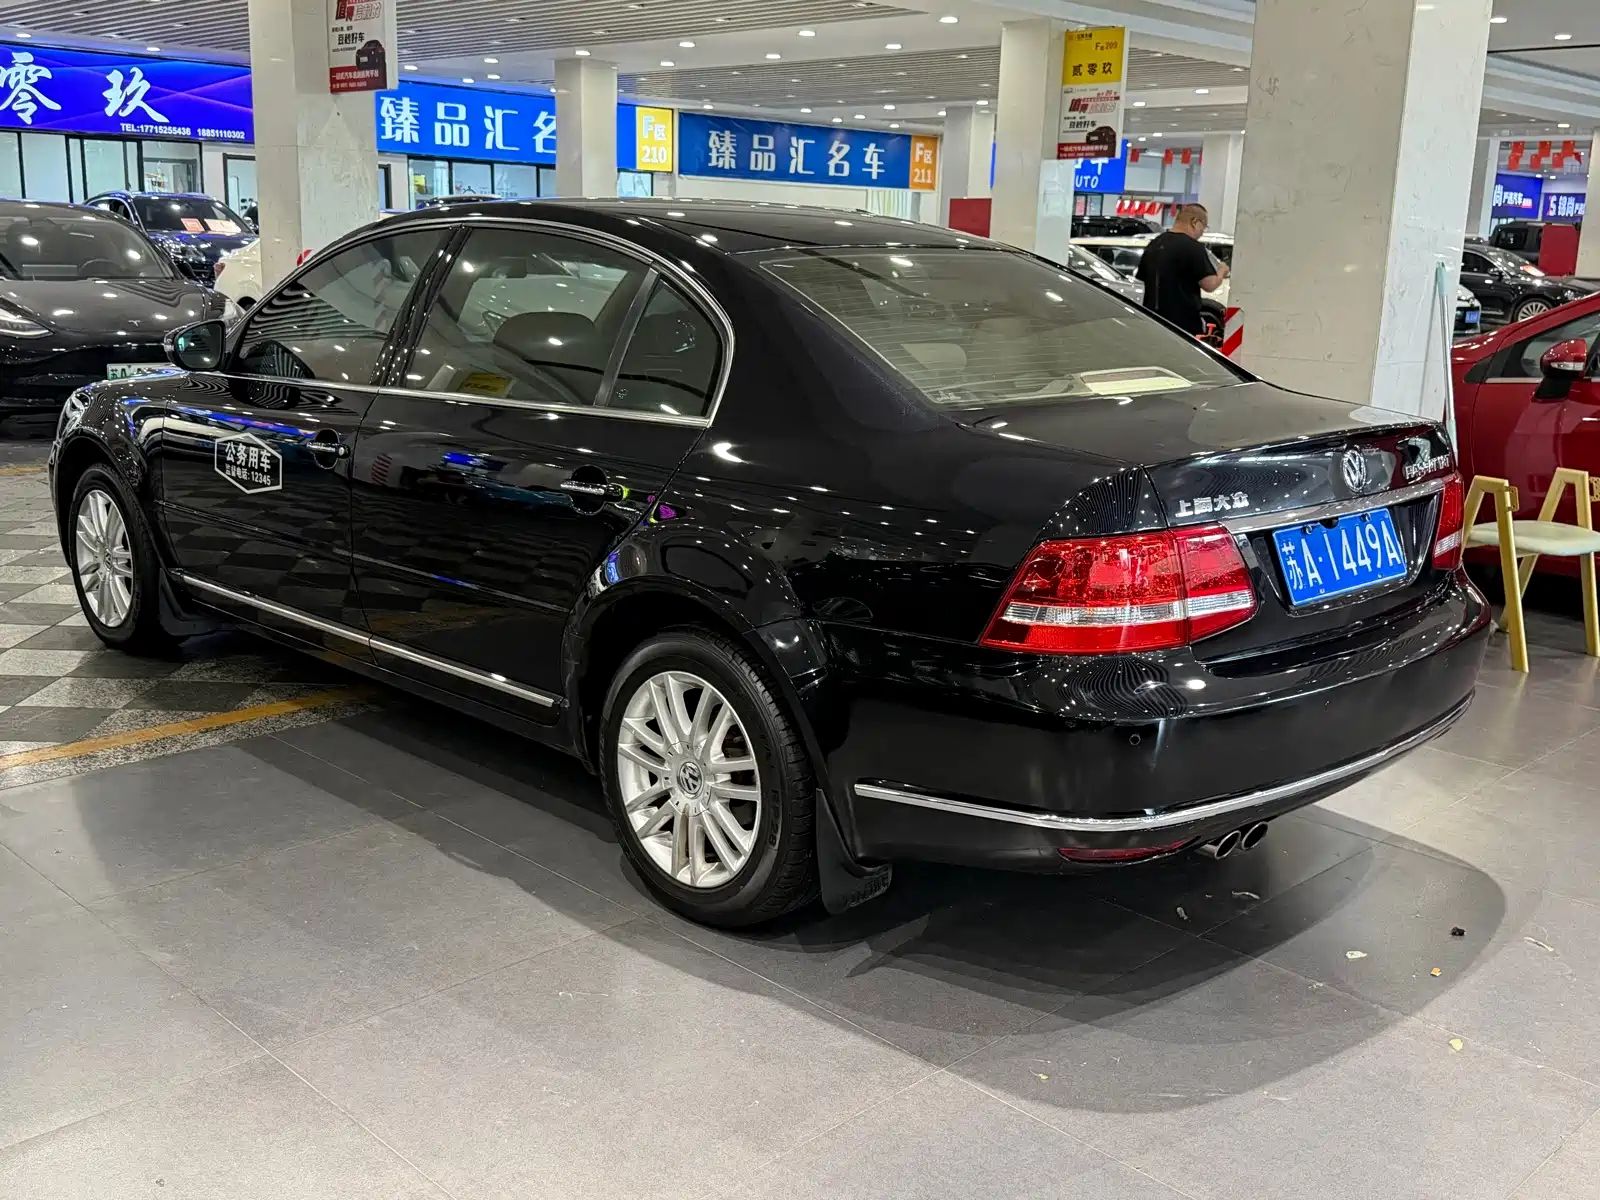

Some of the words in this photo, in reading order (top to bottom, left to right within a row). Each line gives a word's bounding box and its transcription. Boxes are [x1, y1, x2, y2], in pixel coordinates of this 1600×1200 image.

[642, 115, 667, 141] F区
[641, 145, 667, 164] 210
[708, 130, 886, 180] 臻品汇名车
[914, 142, 933, 165] F区
[913, 168, 933, 184] 211
[225, 441, 272, 473] 公务用车
[1174, 491, 1250, 518] 上海大众
